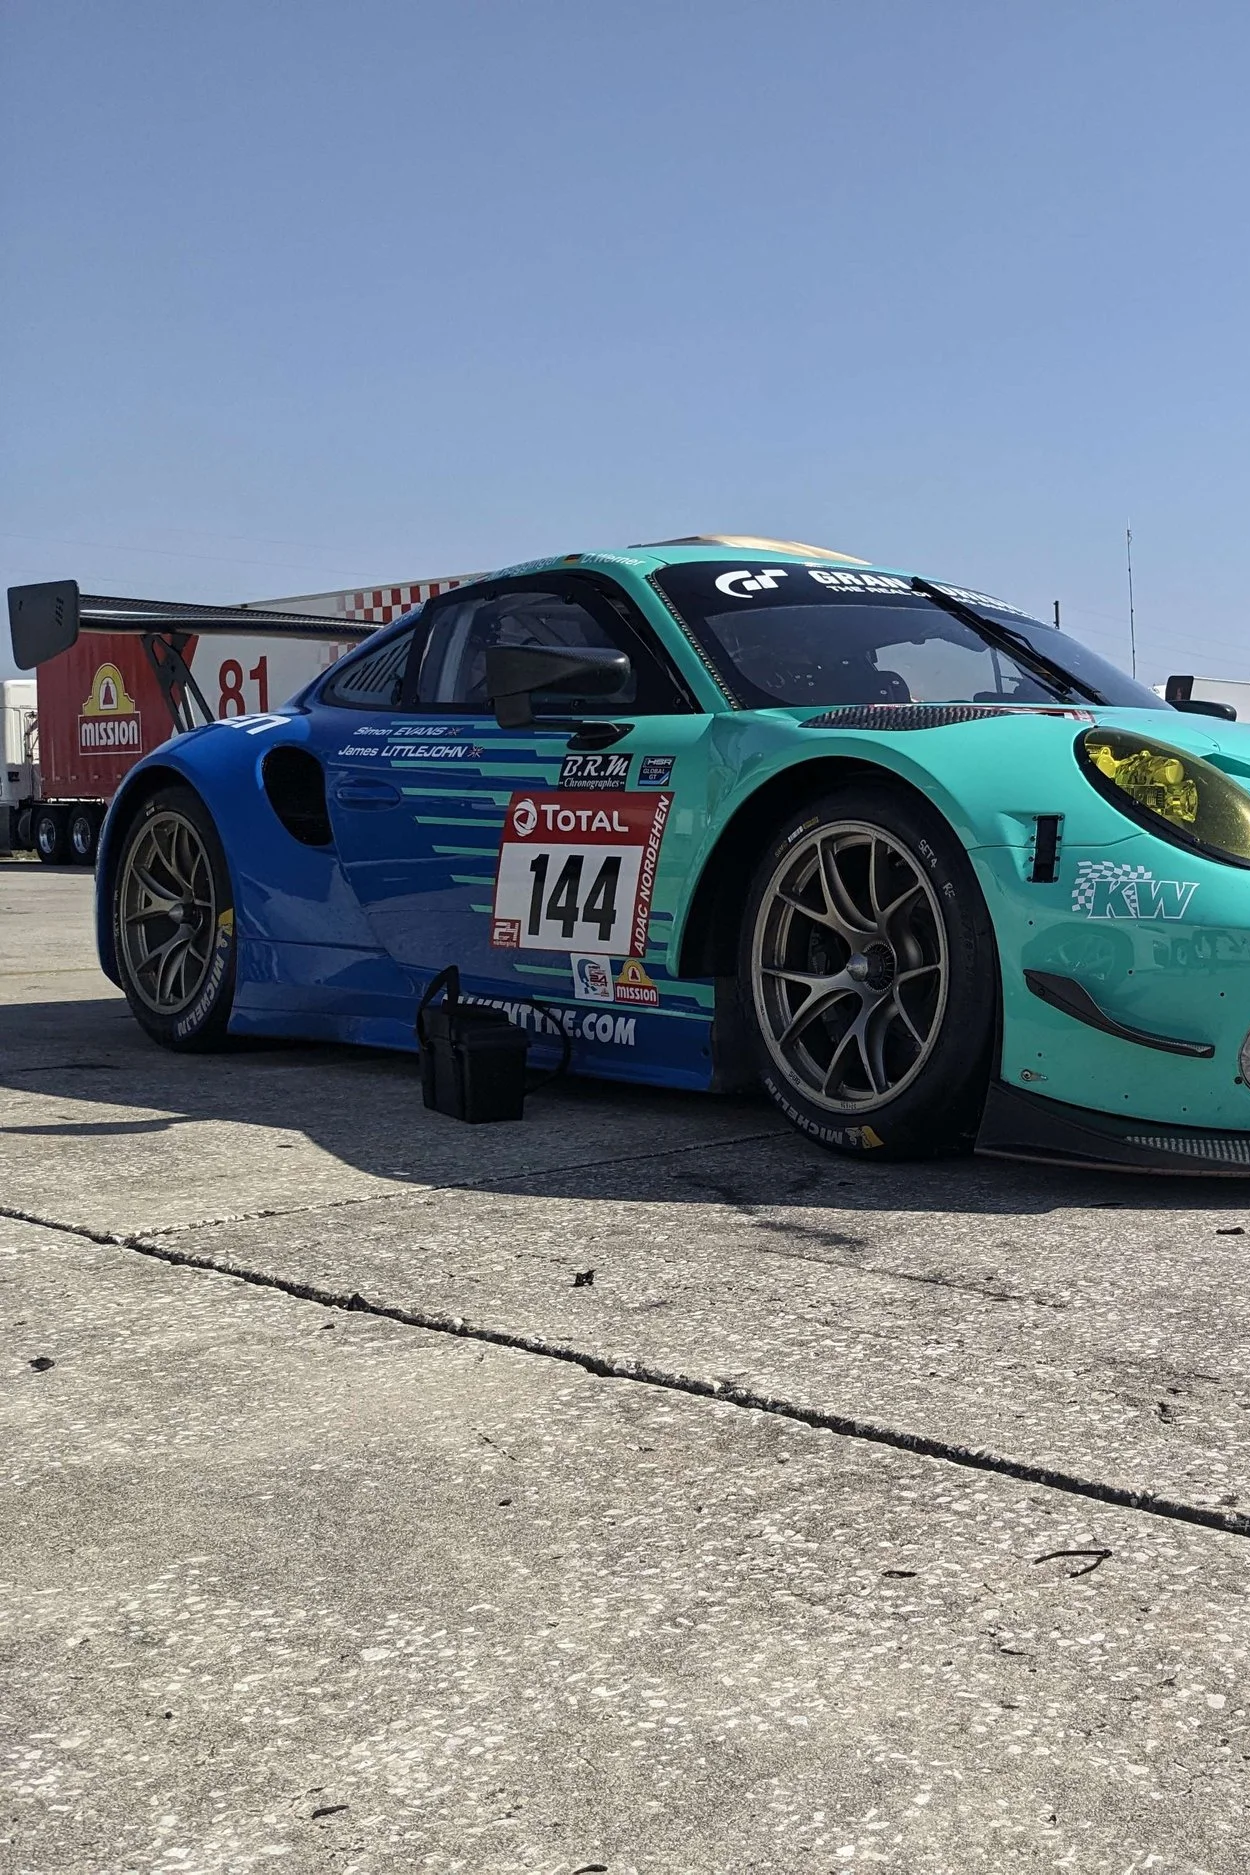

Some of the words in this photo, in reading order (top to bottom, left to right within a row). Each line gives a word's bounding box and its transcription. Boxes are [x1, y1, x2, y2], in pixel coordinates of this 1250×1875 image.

[808, 570, 912, 590] GRAN
[219, 655, 269, 719] 81
[81, 720, 139, 747] MISSION
[338, 744, 379, 757] James
[381, 745, 468, 758] LITTLEJOHN
[353, 726, 393, 736] Simon
[393, 726, 448, 736] EVANS
[541, 804, 629, 833] TOTAL
[527, 853, 623, 942] 144
[1086, 879, 1200, 919] KW
[634, 905, 648, 956] ADAC
[177, 953, 225, 1037] MICHELIN
[616, 985, 657, 1002] MISSION
[441, 993, 637, 1046] NTYRE.COM
[764, 1077, 844, 1145] MICHELIN
